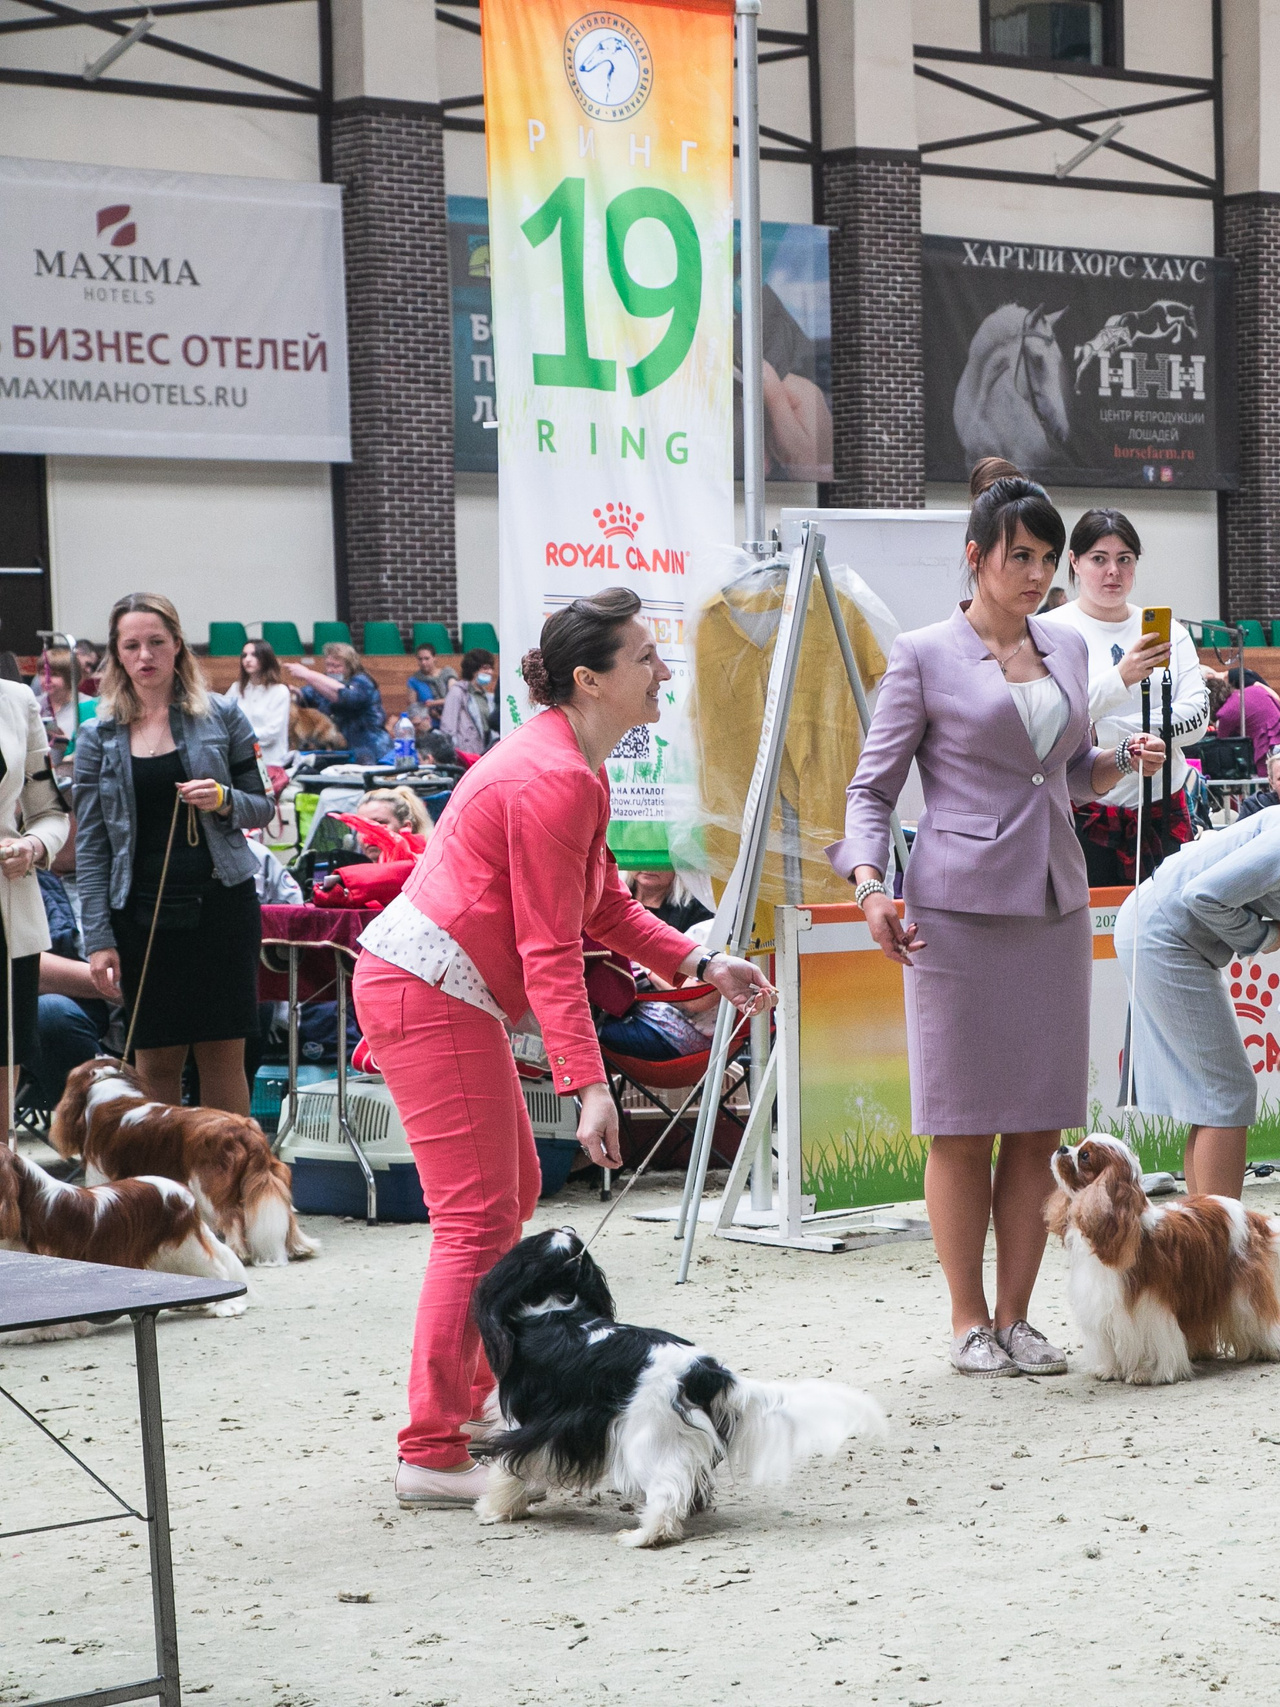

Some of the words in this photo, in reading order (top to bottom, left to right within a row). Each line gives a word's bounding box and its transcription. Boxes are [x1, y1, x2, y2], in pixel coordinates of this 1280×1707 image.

[568, 16, 648, 61] КИНОЛОГИЧЕСКАЯ
[527, 119, 698, 173] РИНГ
[34, 248, 201, 286] MAXIMA
[962, 242, 1065, 273] ХАРТЛИ
[1070, 251, 1137, 279] ХОРС
[1141, 257, 1208, 282] ХАУС
[84, 287, 155, 305] HOTELS
[520, 176, 703, 397] 19
[12, 324, 171, 367] БИЗНЕС
[181, 332, 329, 373] ОТЕЛЕЙ
[1099, 408, 1132, 423] ЦЕНТР
[1133, 410, 1206, 425] РЕПРОДУКЦИИ
[1127, 427, 1180, 442] ЛОШАДЕЙ
[537, 419, 690, 465] RING
[1112, 443, 1196, 460] horsefarm.ru
[546, 541, 620, 569] ROYAL
